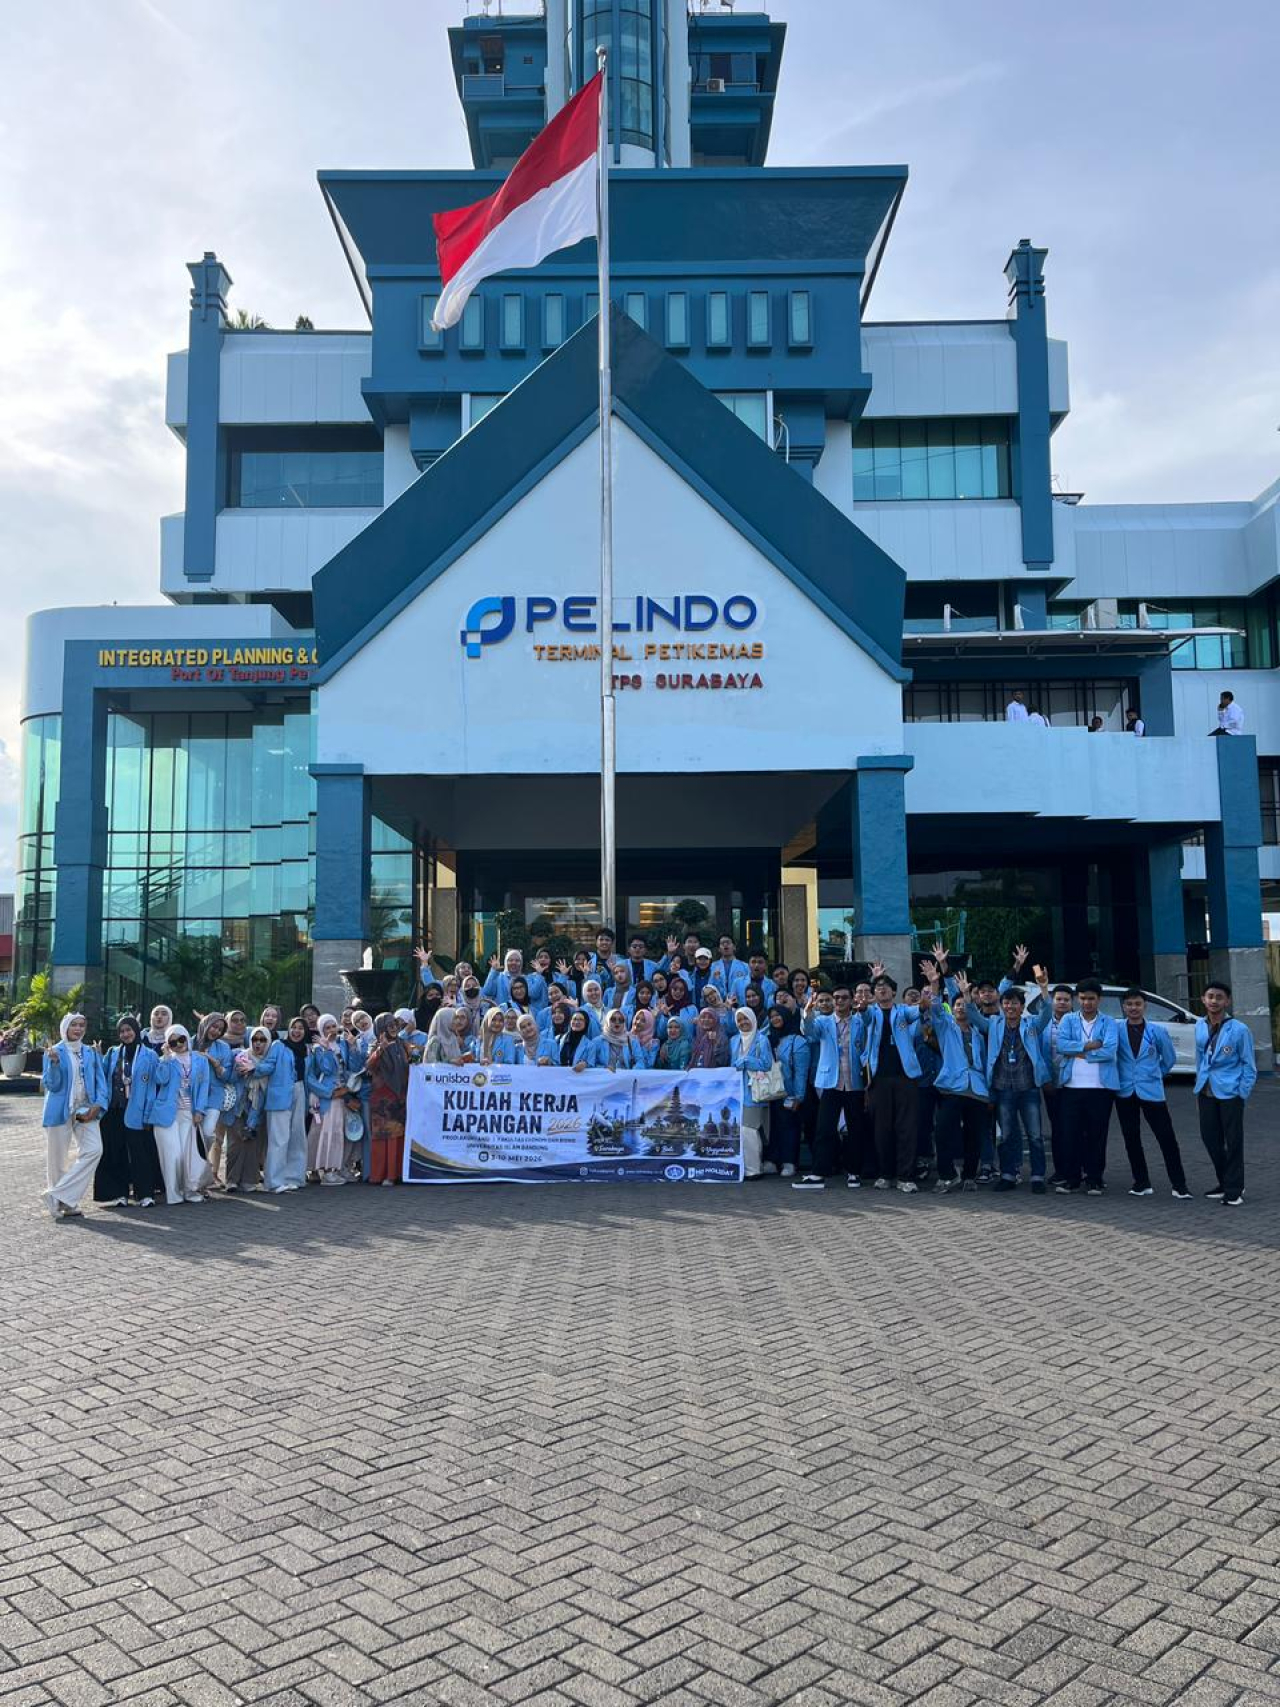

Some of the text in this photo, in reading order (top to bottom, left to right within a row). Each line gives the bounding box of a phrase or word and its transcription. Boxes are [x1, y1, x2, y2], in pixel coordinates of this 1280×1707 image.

[99, 649, 208, 666] INTEGRATED
[211, 647, 293, 665] PLANNING
[296, 647, 308, 664] &
[644, 643, 763, 660] PETIKEMAS
[171, 667, 200, 680] Port
[229, 667, 285, 683] Tanjung
[611, 673, 764, 690] TPS SURABAYA
[435, 1072, 470, 1084] unisba
[443, 1090, 579, 1112] KULIAH KERJA
[442, 1113, 581, 1134] LAPANGAN 2026
